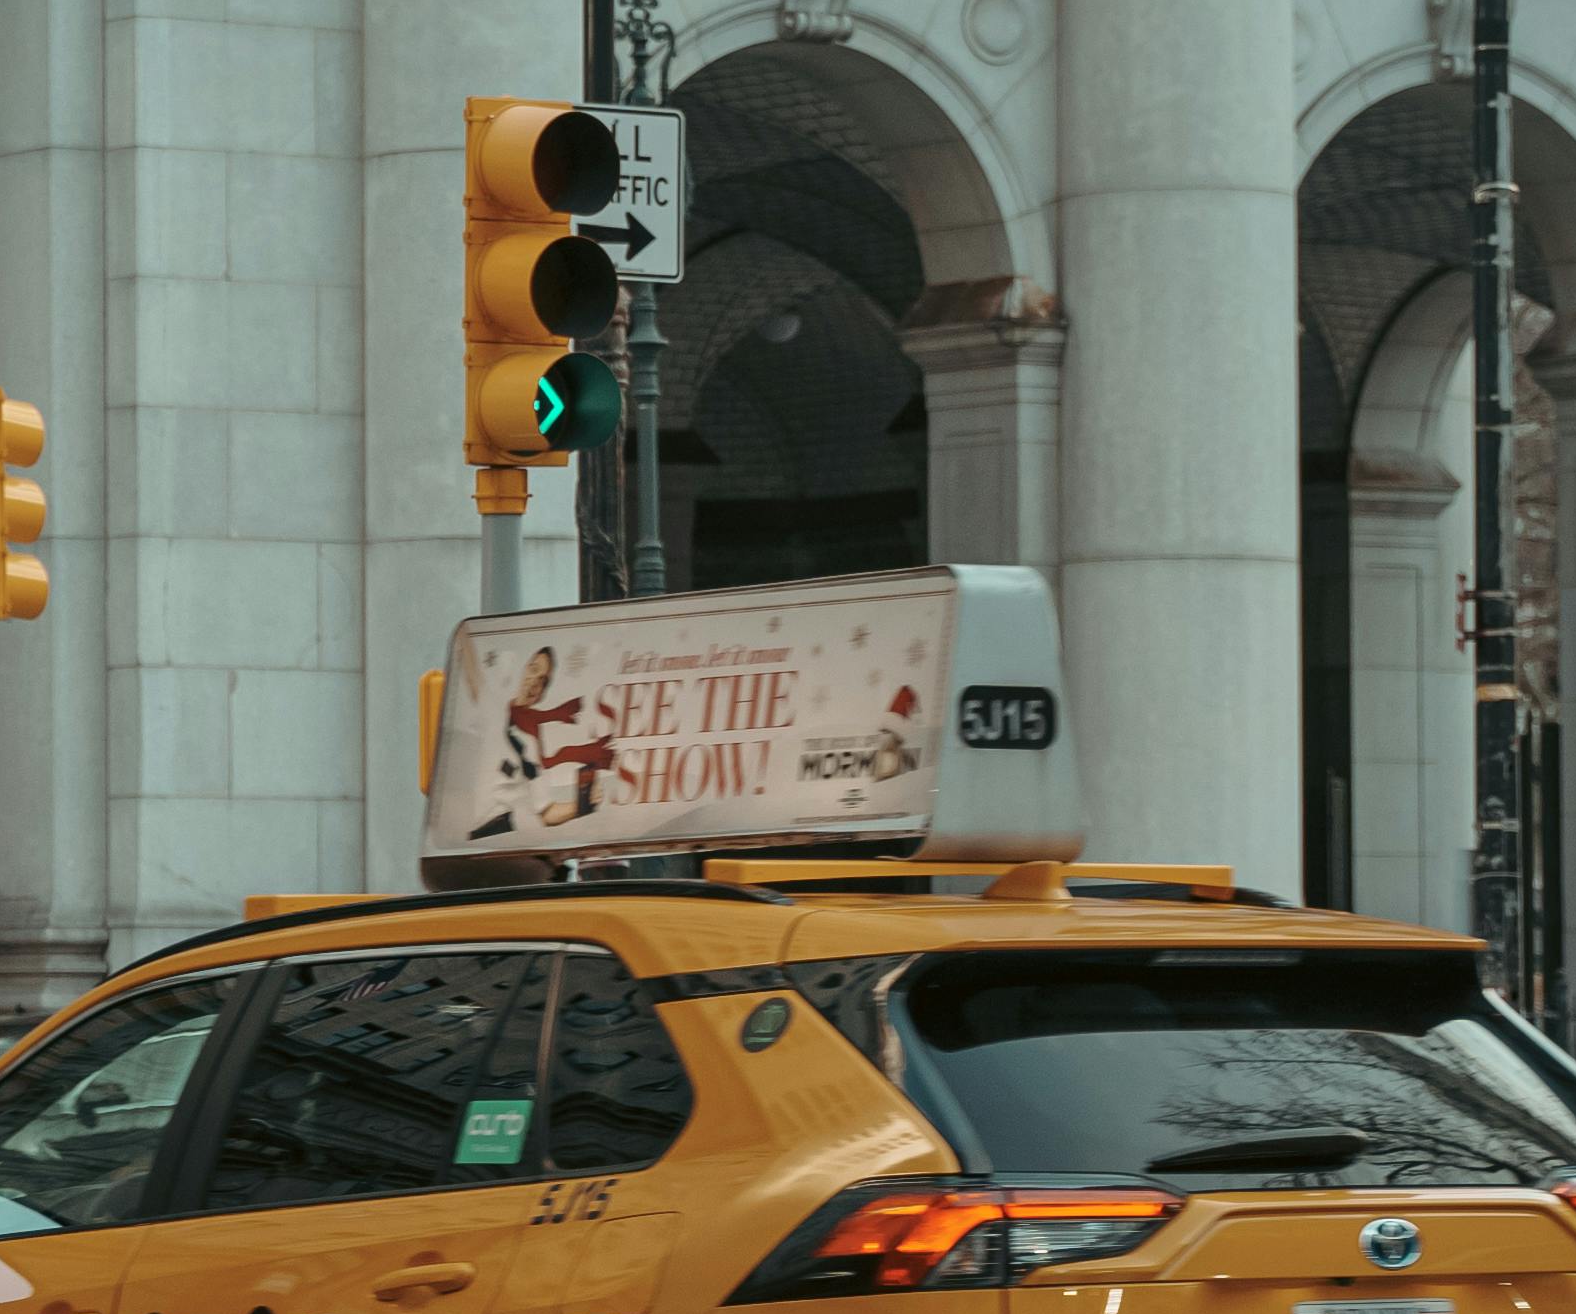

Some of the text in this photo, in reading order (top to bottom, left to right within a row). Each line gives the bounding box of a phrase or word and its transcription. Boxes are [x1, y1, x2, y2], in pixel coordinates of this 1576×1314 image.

[590, 670, 798, 739] SEE THE
[962, 699, 1046, 741] 5J15
[610, 740, 771, 806] SHOW!
[463, 1110, 526, 1136] curb
